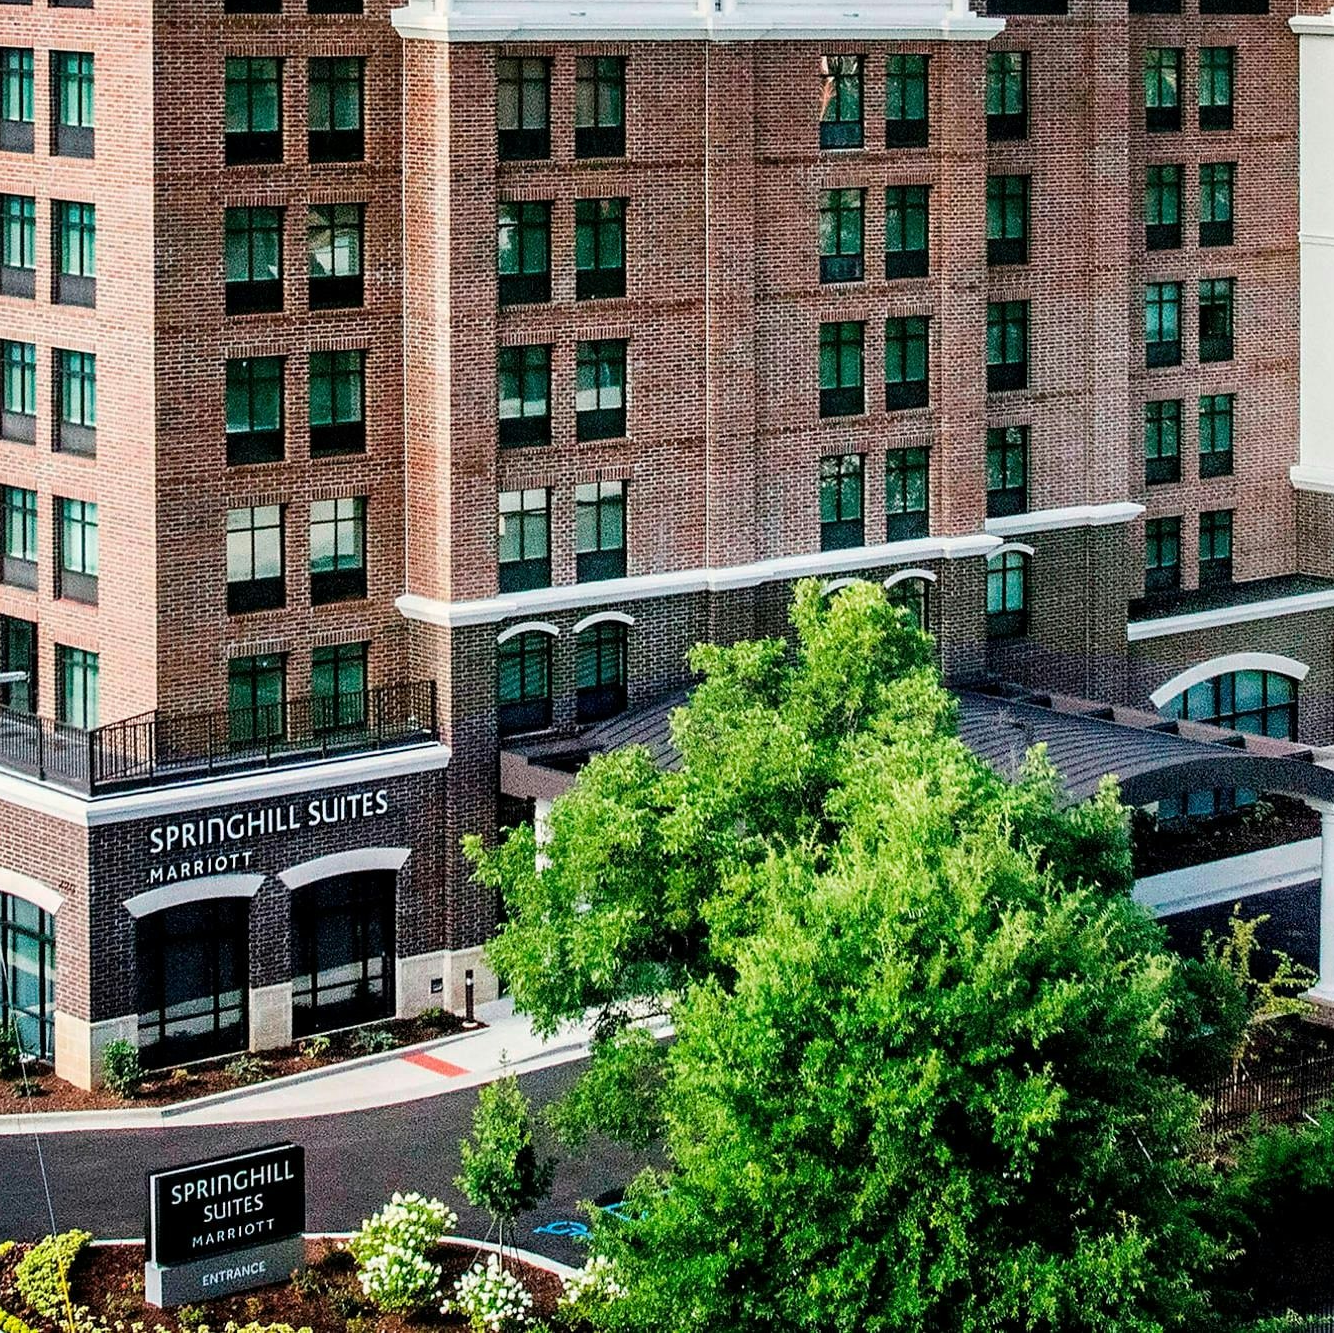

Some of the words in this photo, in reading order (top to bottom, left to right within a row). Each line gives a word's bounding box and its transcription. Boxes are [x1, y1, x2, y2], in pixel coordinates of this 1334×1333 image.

[150, 805, 301, 854] SPRINGHILL
[308, 790, 389, 826] SUITES
[150, 851, 253, 884] MARRIOTT
[171, 1160, 295, 1205] SPRINGHILL
[203, 1193, 264, 1223] SUITES
[192, 1218, 275, 1248] MARRIOTT
[202, 1260, 267, 1287] ENTRANCE
